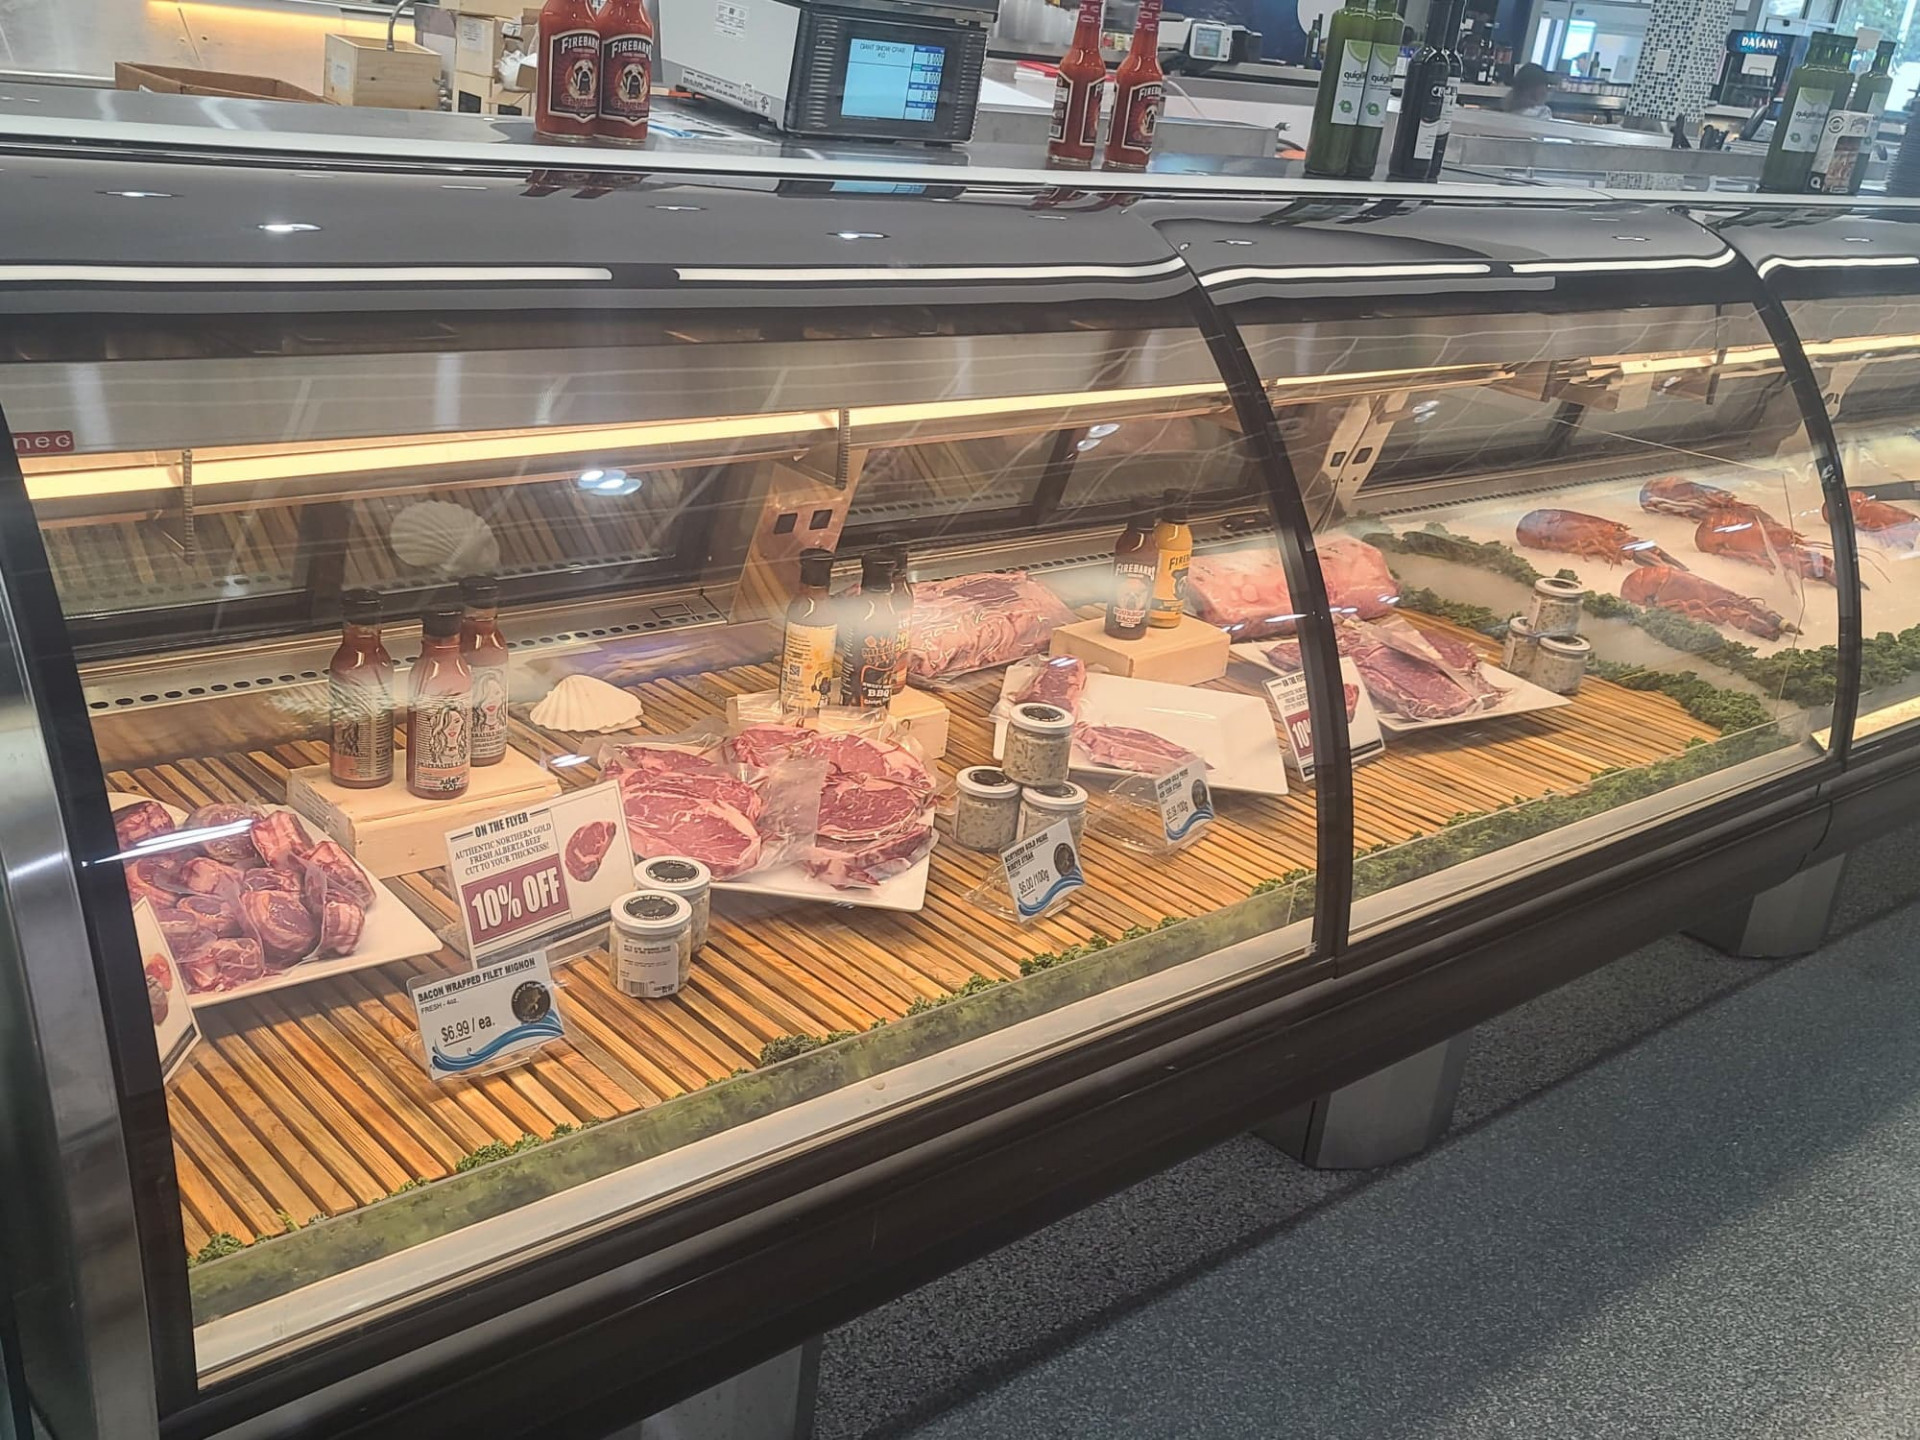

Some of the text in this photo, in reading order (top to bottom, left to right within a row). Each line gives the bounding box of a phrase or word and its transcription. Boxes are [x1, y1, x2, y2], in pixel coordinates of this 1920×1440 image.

[1741, 36, 1778, 49] DASANI
[867, 689, 890, 698] BBQ
[475, 812, 528, 837] ON THE FLYER
[454, 823, 551, 860] AUTHENTIC NORTHERN GOLD
[469, 835, 541, 865] FRESH ALBERTA BEEF
[465, 865, 480, 876] CUT
[479, 861, 490, 871] TO
[490, 854, 511, 867] YOUR
[471, 881, 522, 931] 10%
[522, 866, 560, 914] OFF
[418, 957, 536, 1002] BACON WRAPPED FILET MIGNON
[420, 1003, 442, 1014] FRESH
[441, 1020, 470, 1043] $6.99
[478, 1015, 496, 1030] ea.
